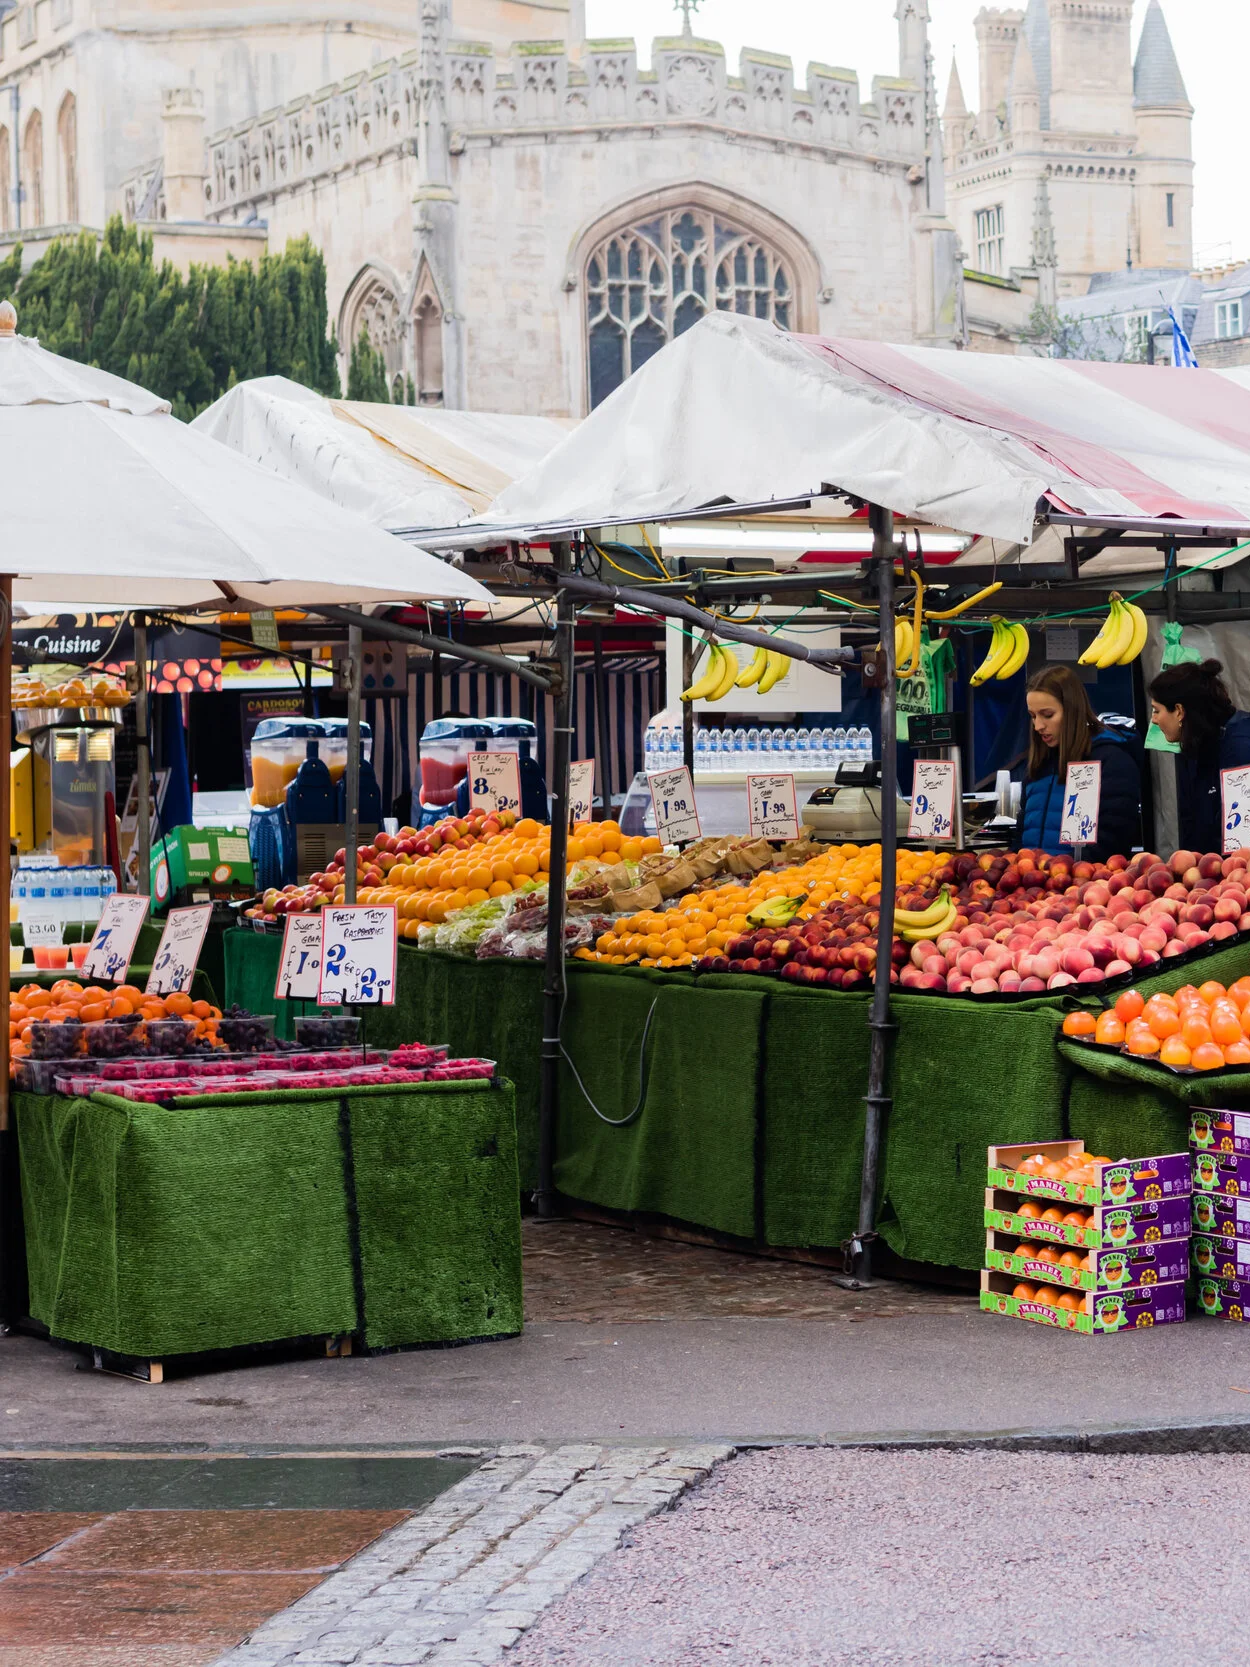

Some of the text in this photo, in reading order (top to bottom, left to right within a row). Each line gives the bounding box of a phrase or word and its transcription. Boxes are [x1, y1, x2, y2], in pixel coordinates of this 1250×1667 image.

[35, 635, 101, 653] Cuisine
[473, 778, 489, 795] 8
[915, 795, 928, 815] 9
[1067, 793, 1078, 818] 7
[1226, 802, 1241, 830] 5
[94, 929, 112, 950] 7
[156, 943, 171, 971] 5
[327, 944, 346, 978] 2
[1106, 1168, 1130, 1177] MANEL
[1032, 1180, 1064, 1194] MANEL
[1106, 1211, 1130, 1220] MANEL
[1028, 1223, 1063, 1236] MANEL
[1103, 1254, 1126, 1263] MANEL
[1028, 1263, 1060, 1277] MANEL
[1100, 1297, 1122, 1306] MANEL
[1022, 1305, 1054, 1318] MANEL
